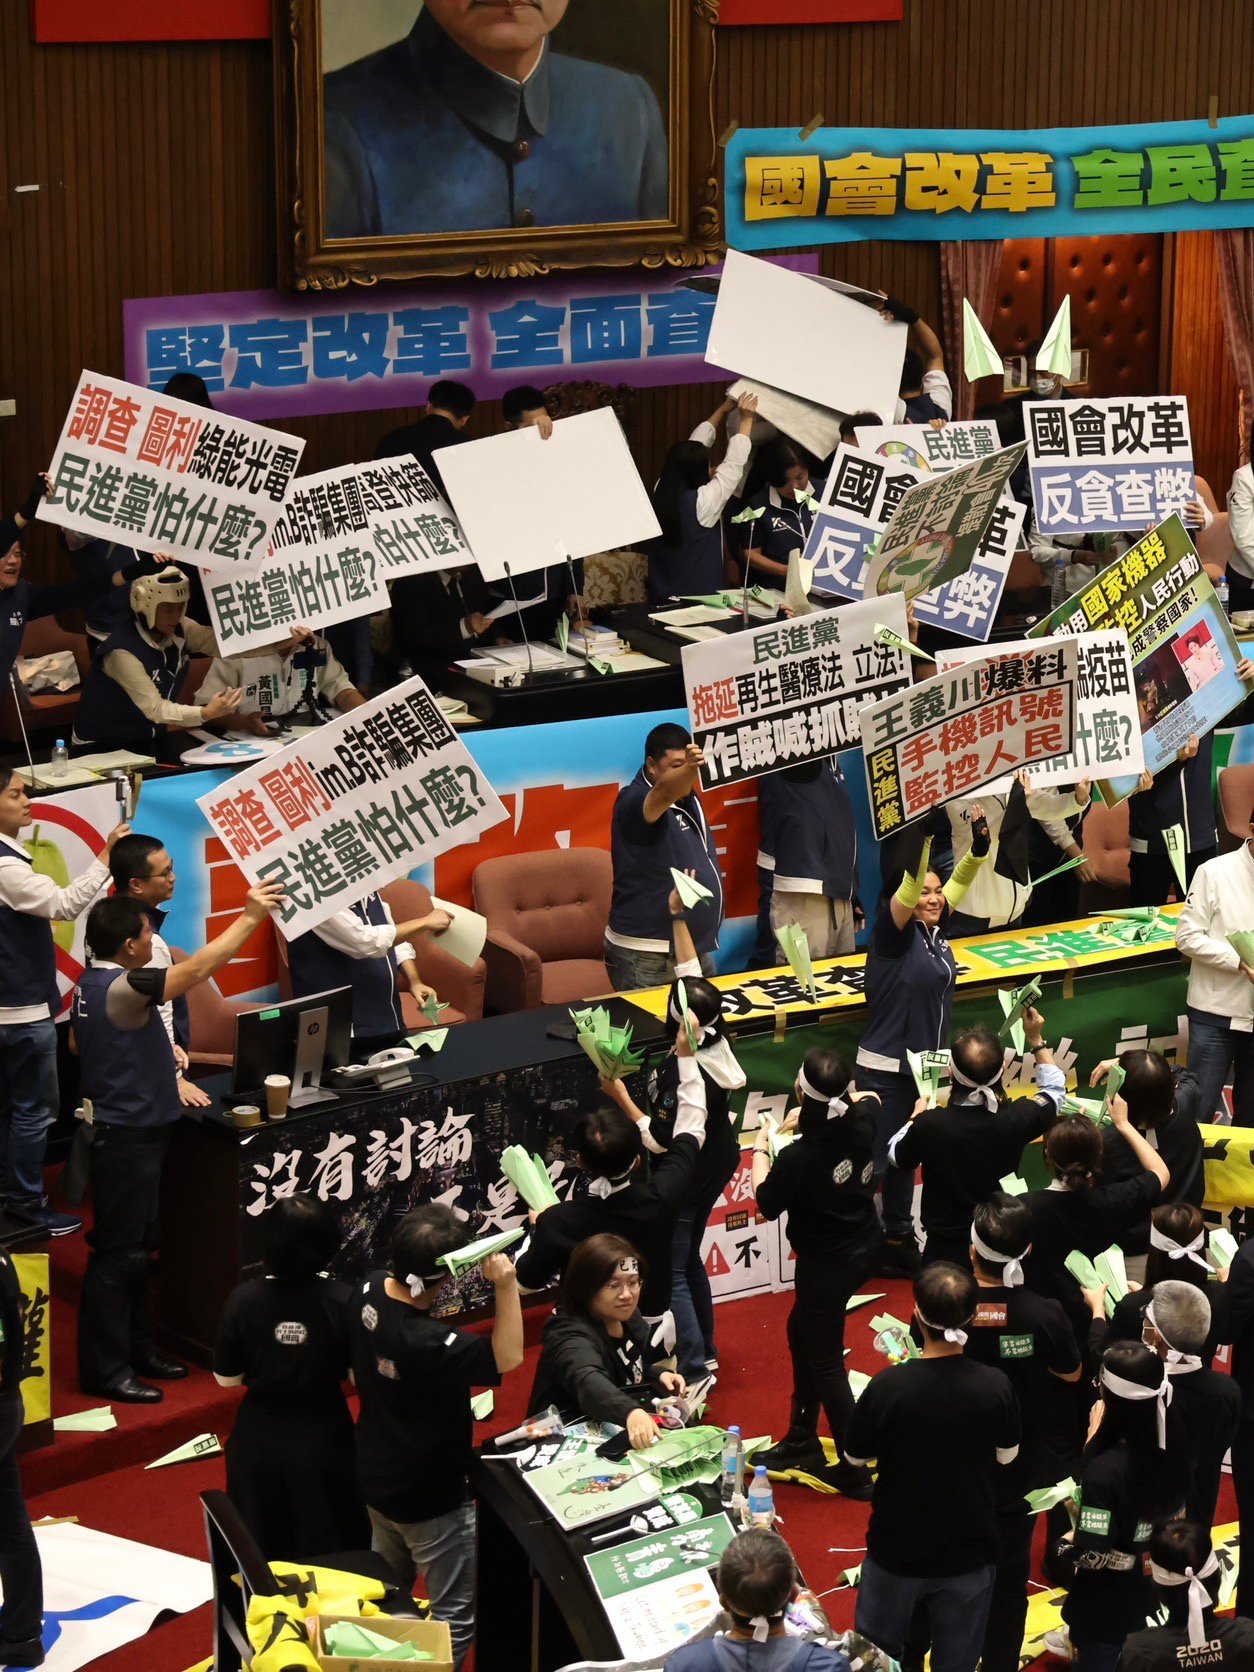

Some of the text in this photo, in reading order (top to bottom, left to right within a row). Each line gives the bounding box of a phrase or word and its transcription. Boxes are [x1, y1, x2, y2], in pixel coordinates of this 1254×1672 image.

[745, 150, 1057, 221] 國會改革
[146, 304, 470, 394] 堅定改革
[66, 383, 142, 455] 調查
[922, 425, 995, 462] 民進黨
[1029, 402, 1190, 458] 國會改革
[45, 451, 268, 562] 民進黨怕什麼?
[828, 453, 1017, 559] 國會革
[1039, 468, 1199, 526] 反貪查弊
[211, 546, 379, 642] 民進黨怕什麼?
[811, 526, 997, 629] 反弊
[752, 616, 841, 665] 民進黨
[901, 687, 1064, 773] 手機訊號
[904, 723, 1063, 815] 監控人民
[209, 786, 284, 860] 調查
[871, 749, 902, 833] 民進黨
[255, 764, 488, 925] 民進黨怕什麼?
[246, 1106, 475, 1217] 沒有討論
[734, 1235, 761, 1268] 不
[1176, 1639, 1222, 1659] 2020
[1179, 1651, 1223, 1669] TAIWAN
